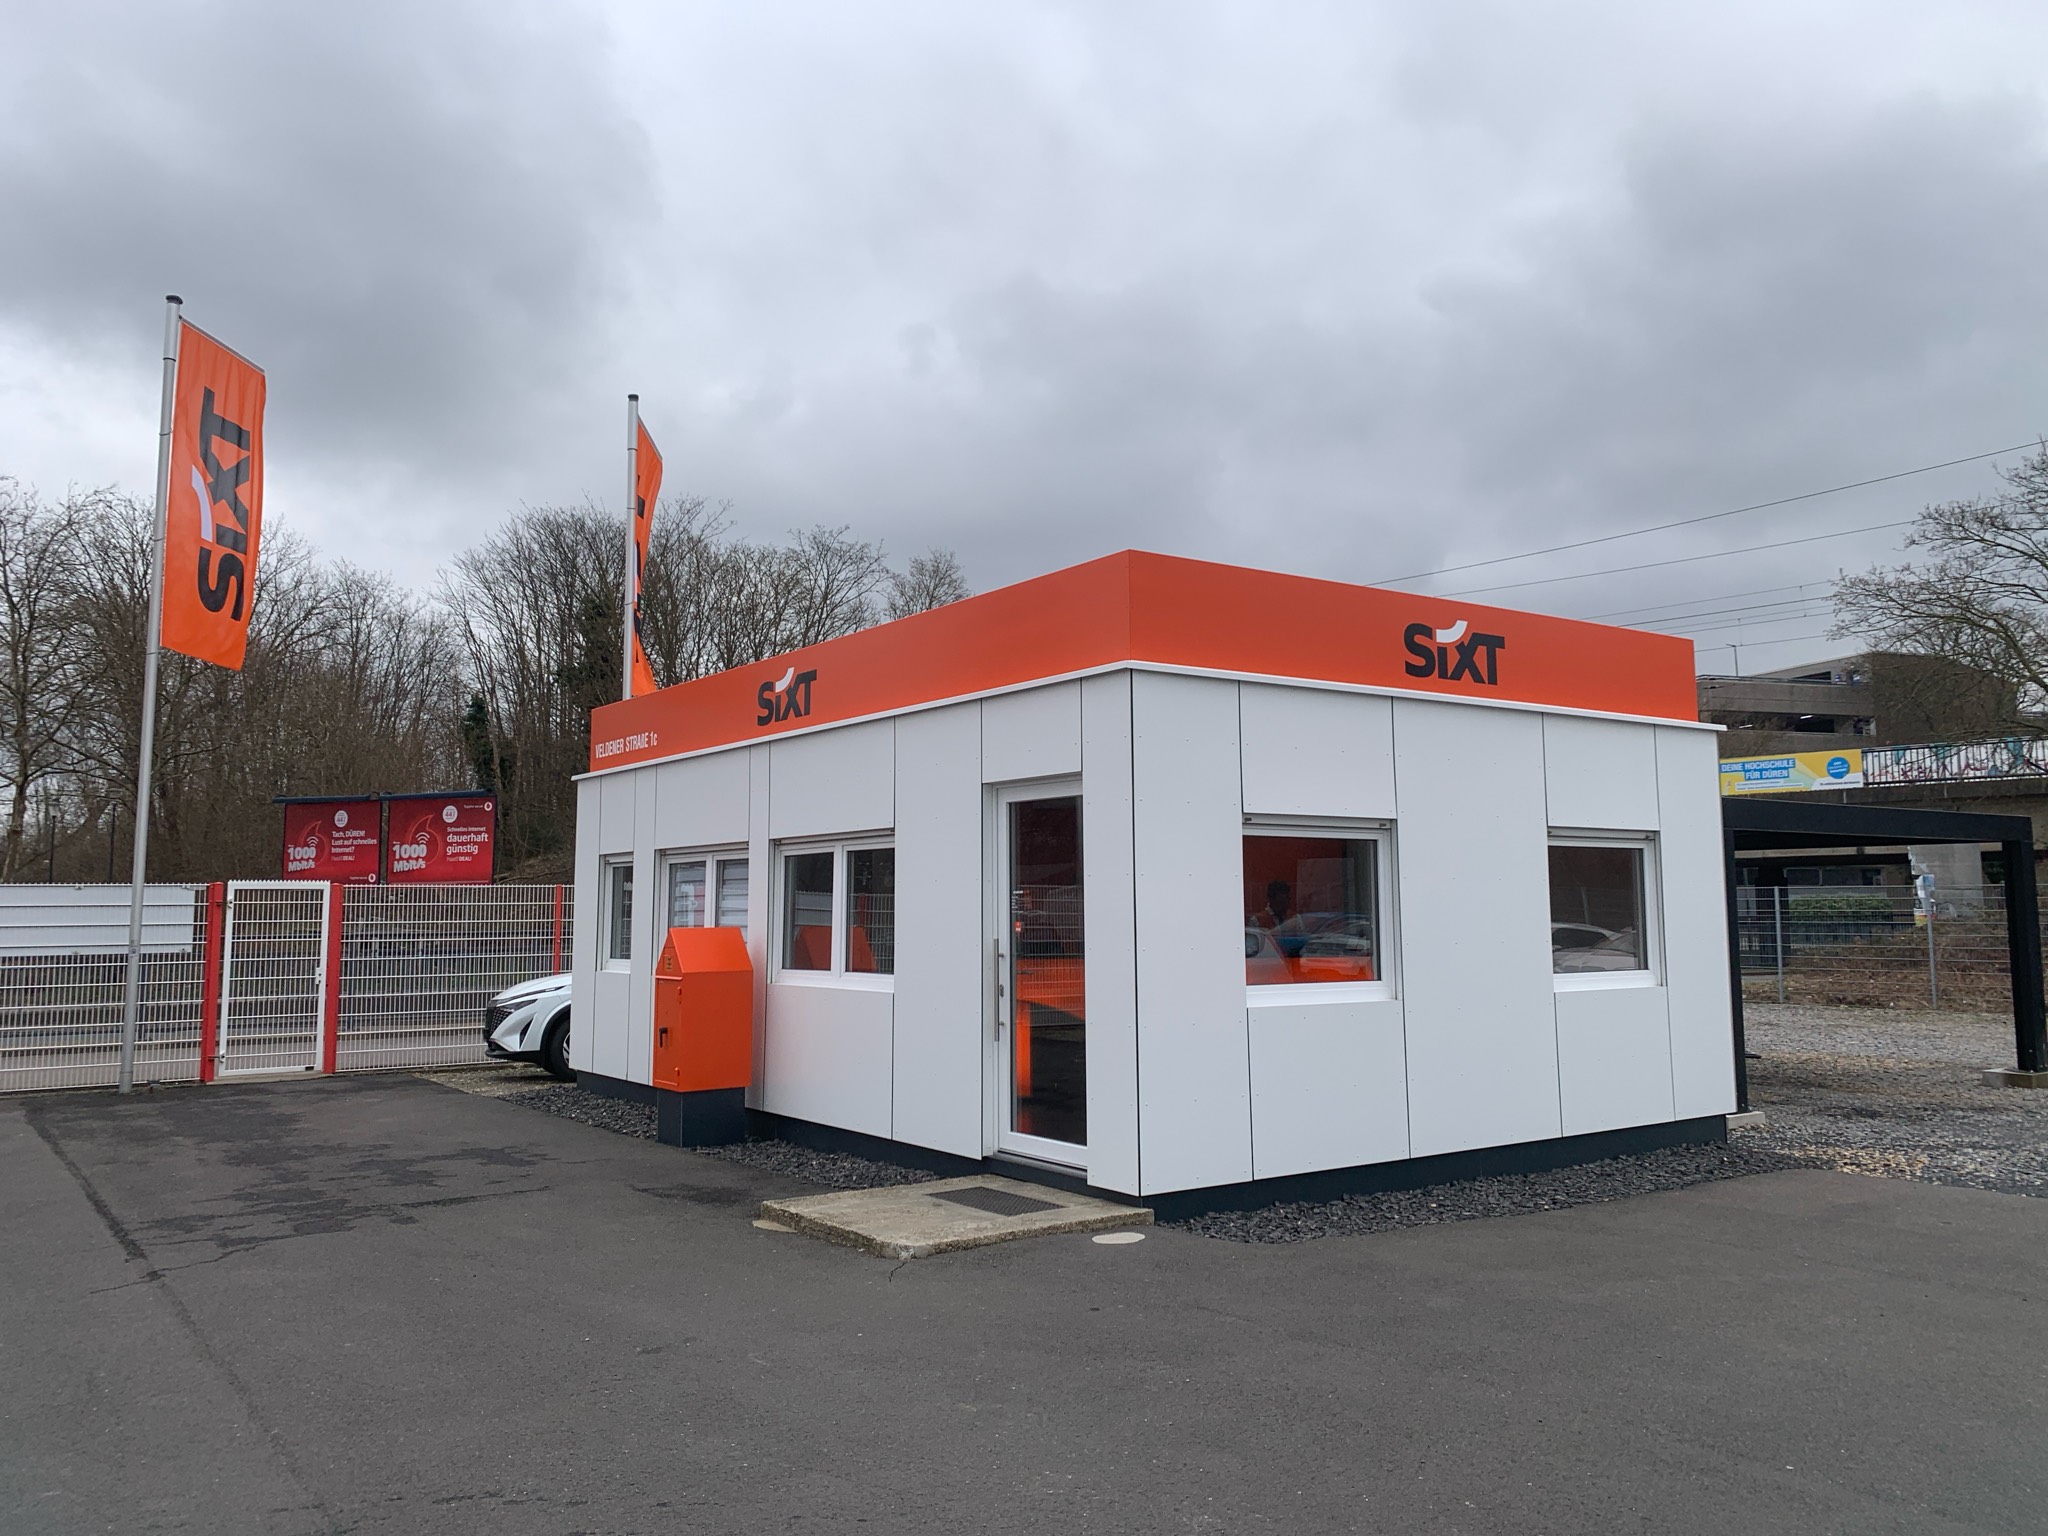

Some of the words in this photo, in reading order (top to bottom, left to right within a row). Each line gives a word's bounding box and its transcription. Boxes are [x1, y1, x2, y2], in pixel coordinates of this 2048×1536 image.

[595, 738, 625, 759] VELDENER
[1721, 763, 1744, 772] DEINE
[1744, 759, 1795, 770] HOCHSCHULE
[1745, 770, 1762, 780] FÜR
[1762, 769, 1789, 779] DÜREN
[446, 833, 489, 843] dauerhaft
[287, 846, 317, 860] 1000
[392, 844, 427, 859] 1000
[446, 843, 479, 856] günstig
